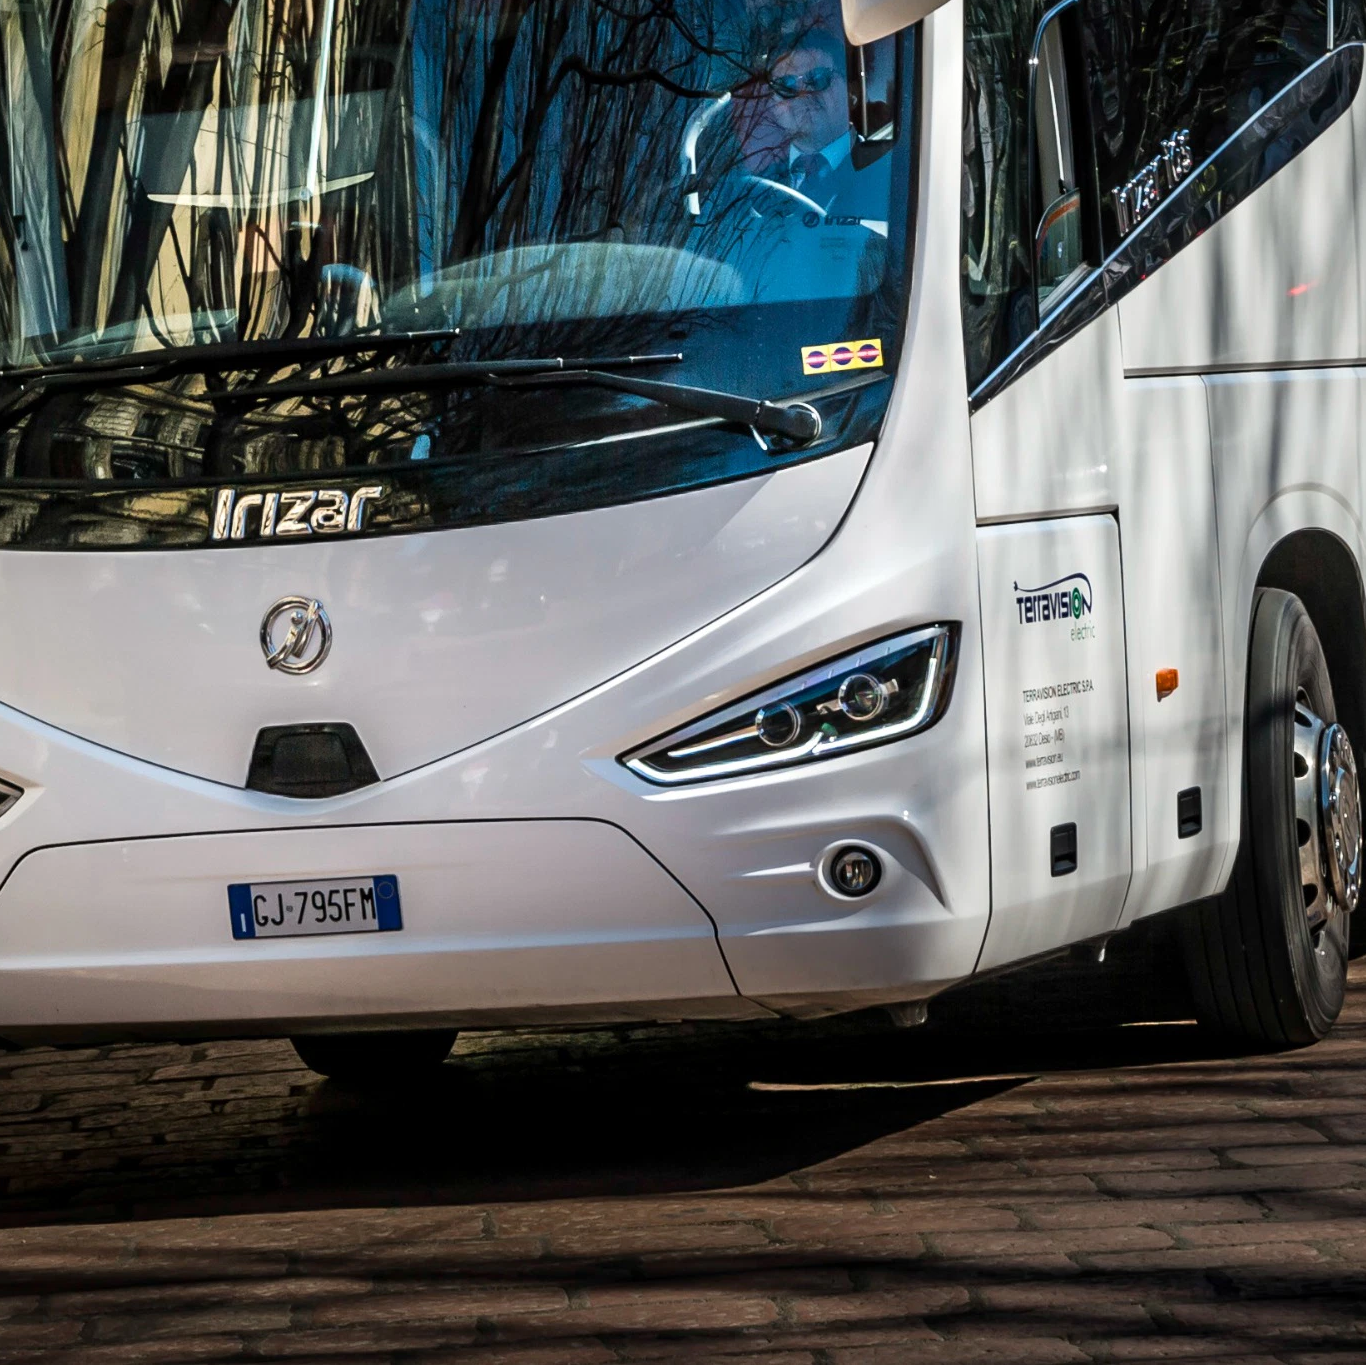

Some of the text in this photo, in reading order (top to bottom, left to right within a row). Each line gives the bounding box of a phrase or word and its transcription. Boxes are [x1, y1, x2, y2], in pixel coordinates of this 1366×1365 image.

[212, 486, 383, 540] Irizar
[1071, 620, 1095, 642] electric
[1023, 686, 1056, 703] TERRAVISION
[1057, 681, 1081, 697] ELECTRIC
